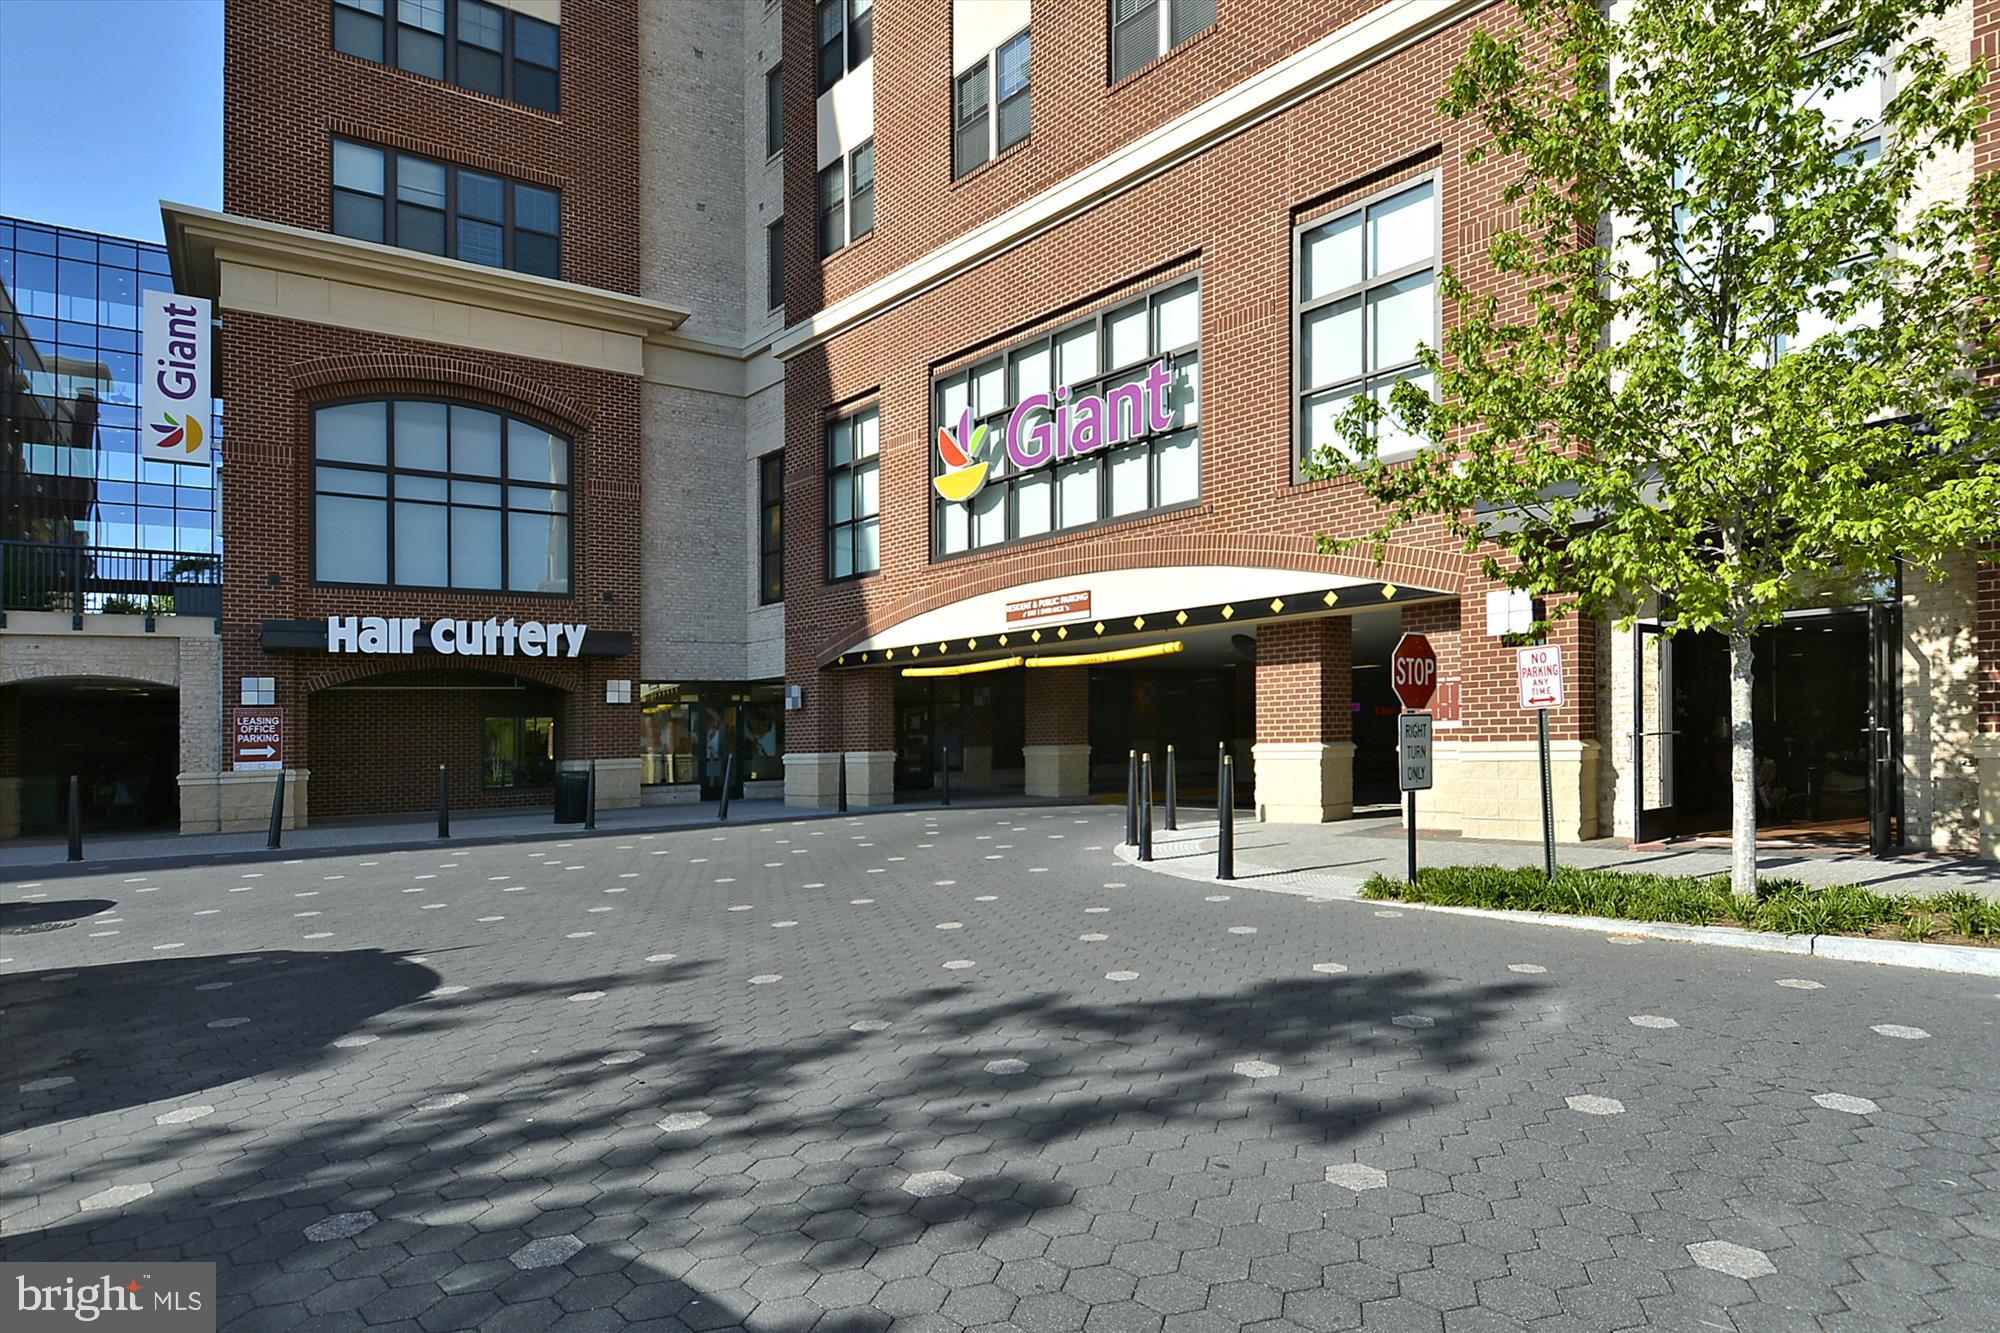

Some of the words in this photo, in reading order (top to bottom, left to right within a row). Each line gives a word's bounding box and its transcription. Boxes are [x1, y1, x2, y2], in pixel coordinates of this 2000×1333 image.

[157, 302, 198, 400] Giant
[1006, 358, 1176, 470] Giant
[328, 615, 421, 654] Hair
[1531, 652, 1547, 664] NO
[1396, 657, 1434, 686] STOP
[1522, 664, 1558, 679] PARKING
[1533, 679, 1548, 687] ANY
[1531, 687, 1551, 696] TIME
[237, 717, 279, 725] LEASING
[240, 725, 276, 733] OFFICE
[1405, 723, 1427, 738] RIGHT
[237, 734, 279, 743] PARKING
[1407, 745, 1426, 760] TURN
[1407, 766, 1426, 781] ONLY
